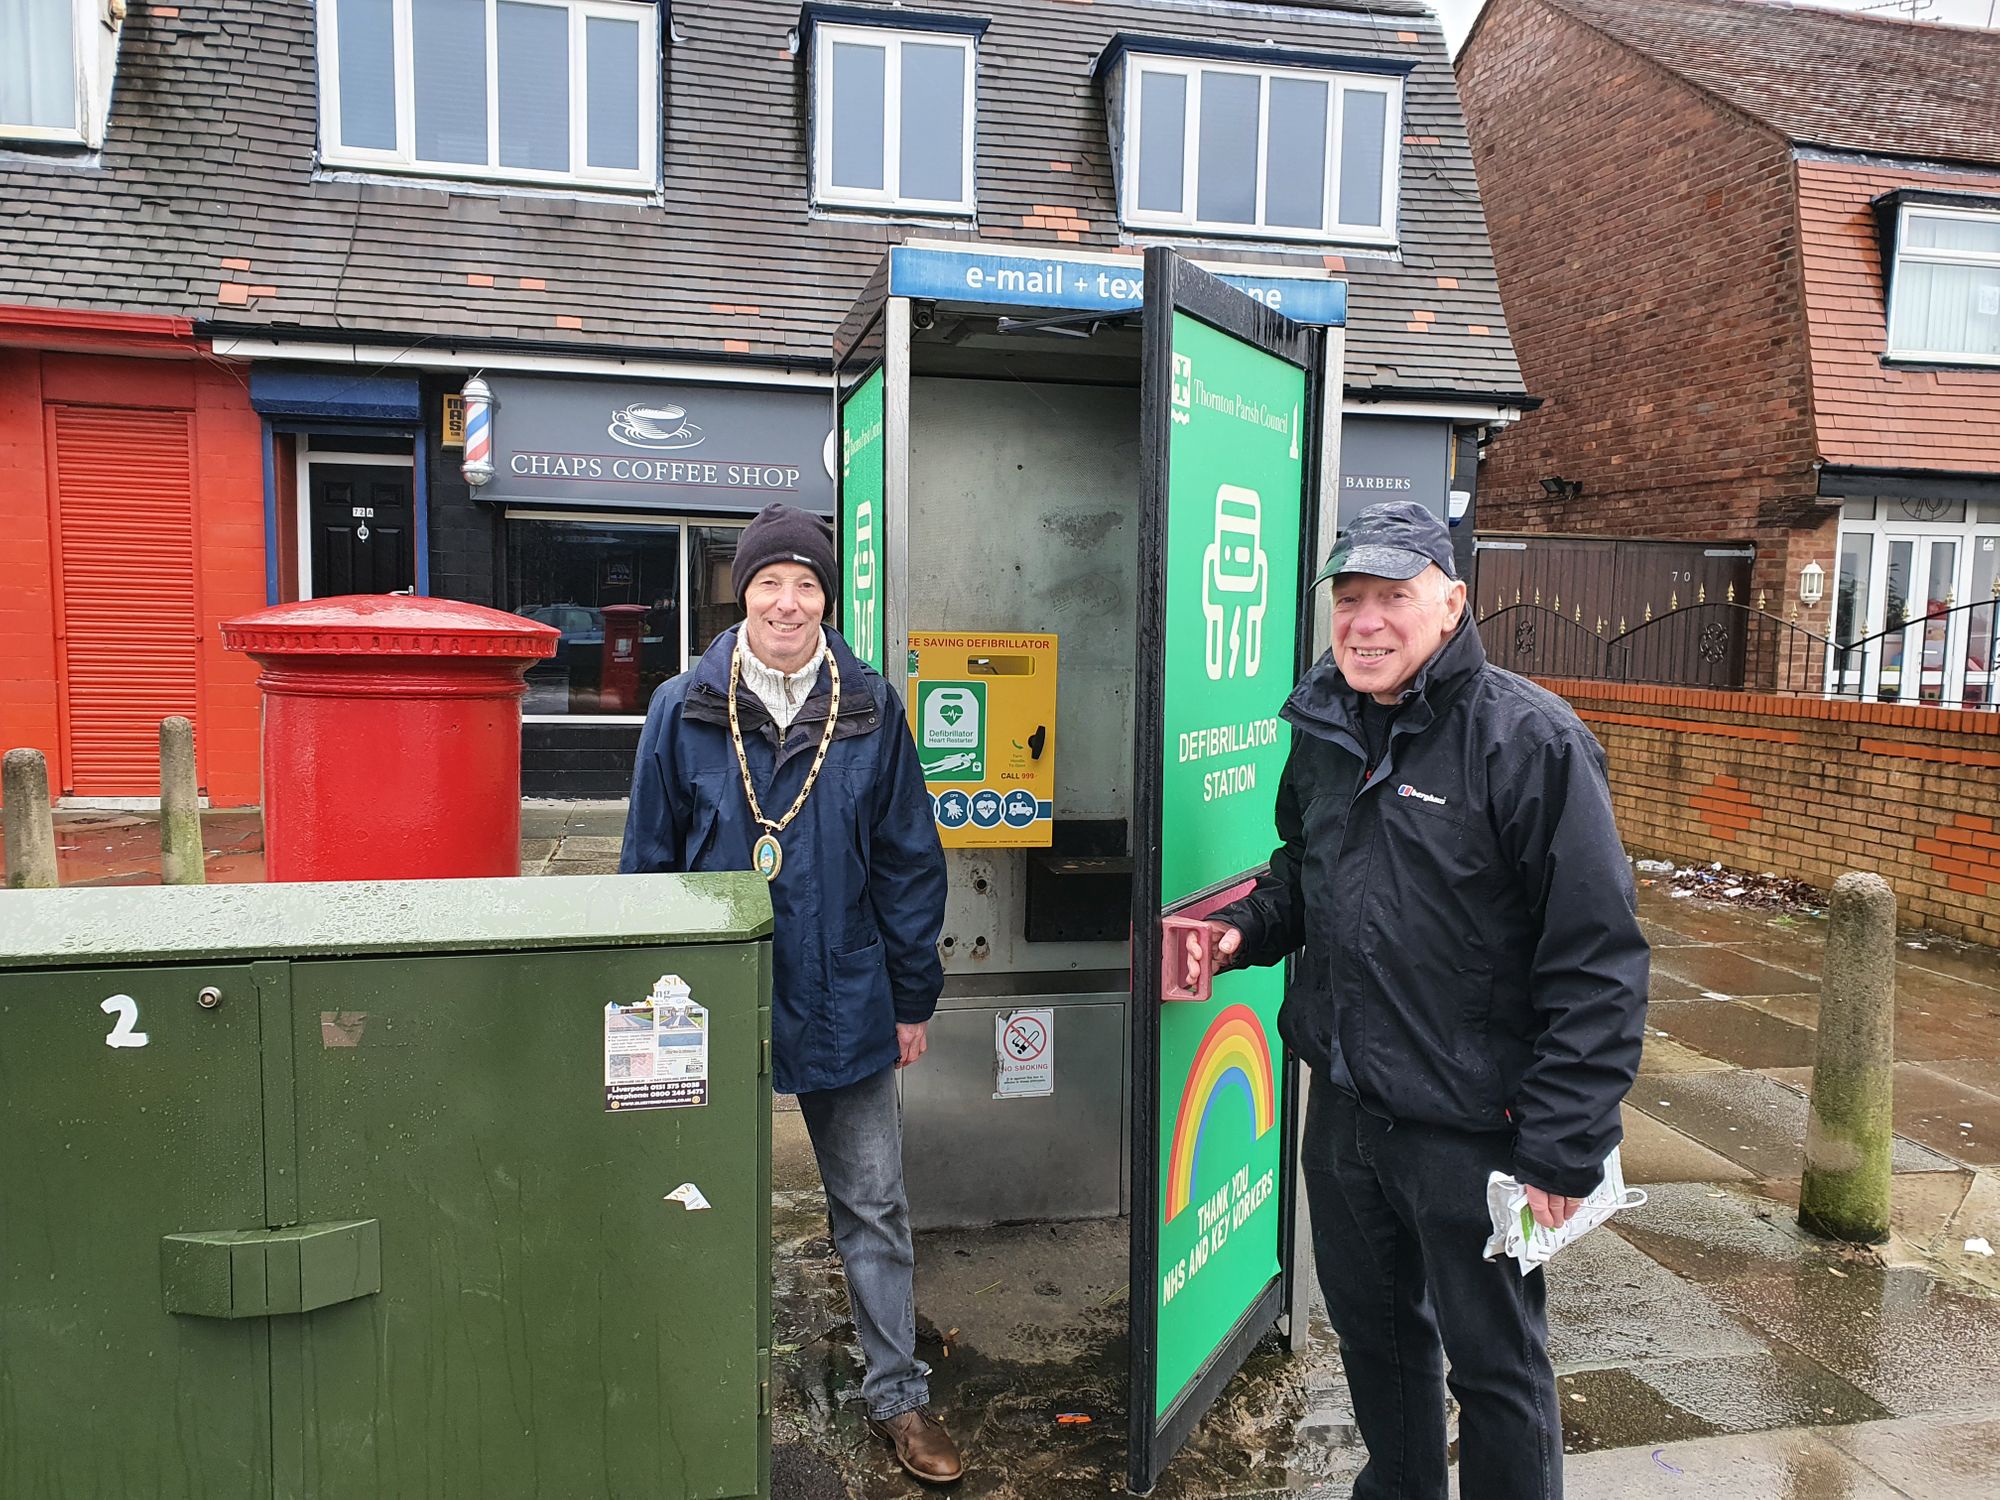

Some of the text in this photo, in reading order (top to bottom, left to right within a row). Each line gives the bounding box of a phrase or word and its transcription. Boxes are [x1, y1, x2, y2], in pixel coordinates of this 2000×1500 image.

[966, 265, 1062, 294] e-mail
[1097, 272, 1143, 300] tex
[1194, 378, 1288, 434] Thornton Parish Council
[511, 454, 800, 488] CHAPS COFFEE SHOP
[1345, 477, 1411, 490] BARBERS
[908, 637, 1050, 649] FE SAVING DEFIBRILLATOR
[929, 729, 974, 738] Defibrillator
[1179, 718, 1277, 763] DEFIBRILLATOR
[1001, 772, 1035, 780] CALL 999
[1203, 763, 1255, 802] STATION
[100, 994, 149, 1048] 2
[1015, 1063, 1049, 1072] SMOKING
[1197, 1163, 1249, 1236] THANK YOU
[1163, 1168, 1273, 1307] NHS AND KEY WORKERS
